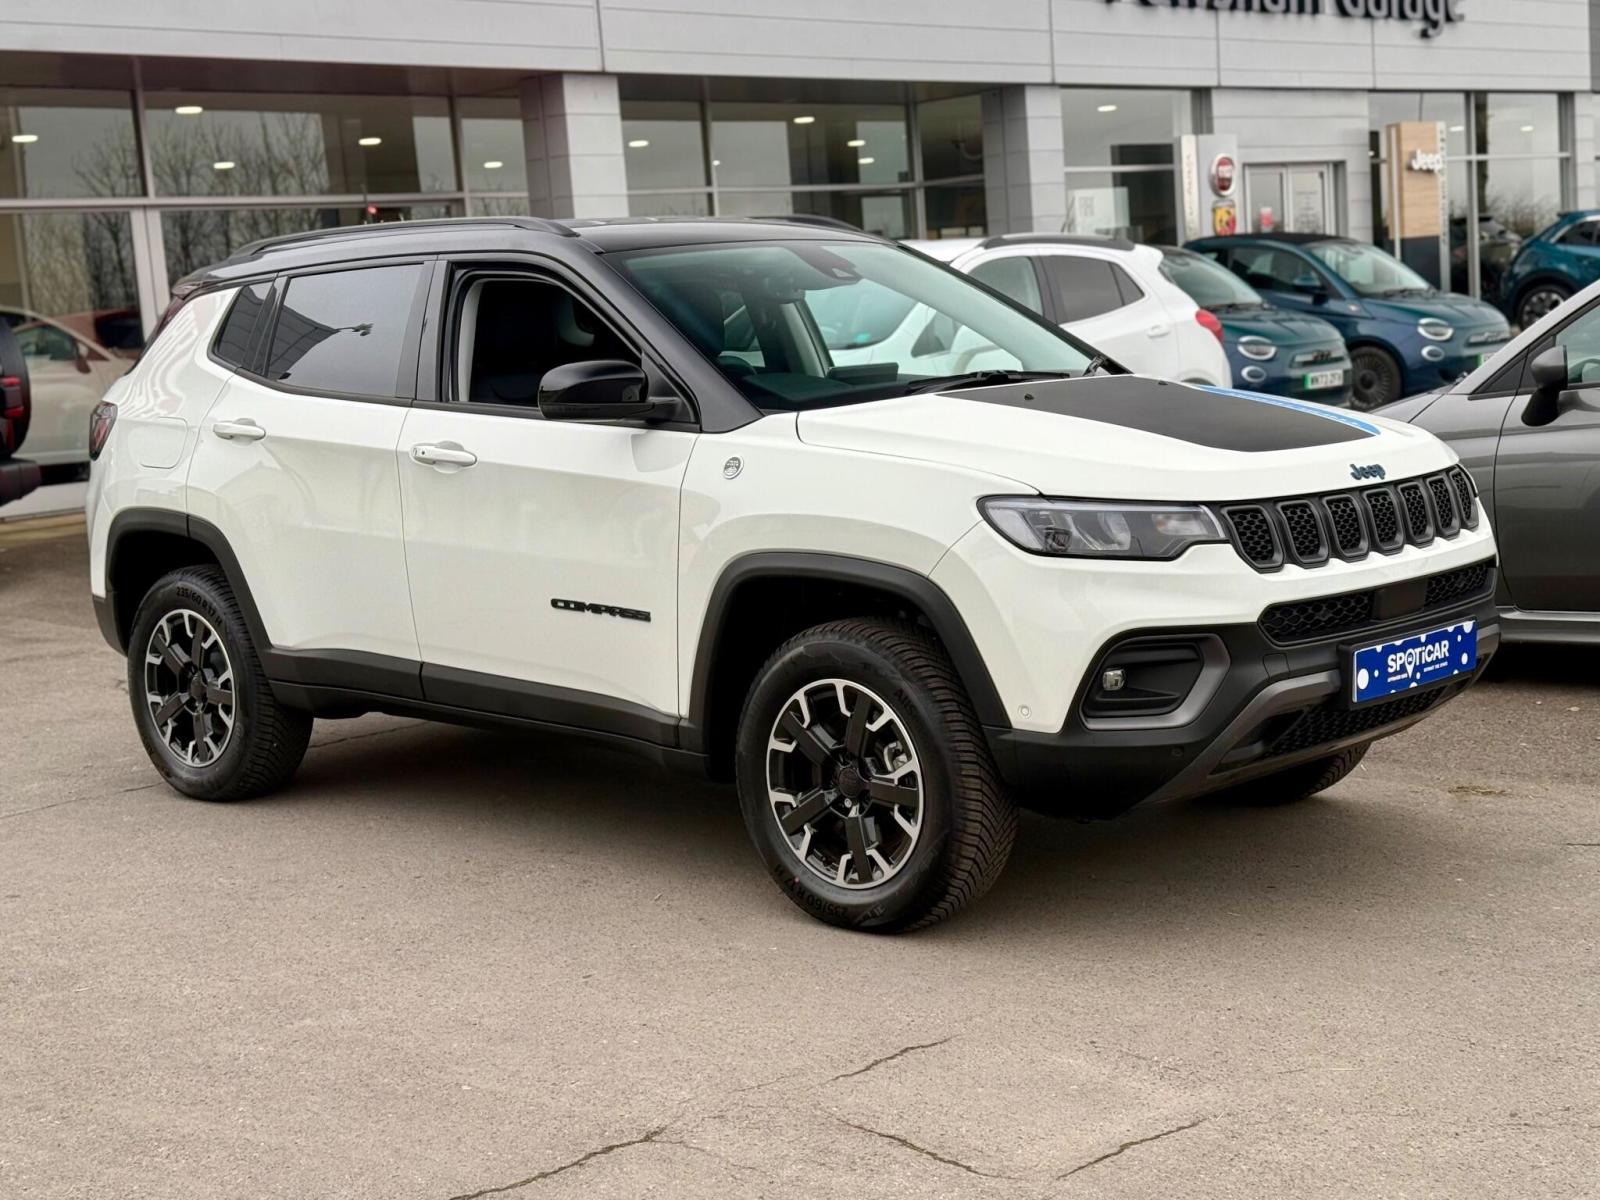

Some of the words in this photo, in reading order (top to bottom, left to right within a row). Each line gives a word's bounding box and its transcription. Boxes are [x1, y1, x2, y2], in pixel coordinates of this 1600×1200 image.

[1411, 149, 1441, 174] Jeep
[1350, 463, 1386, 480] Jeep
[551, 598, 651, 622] COMPASS
